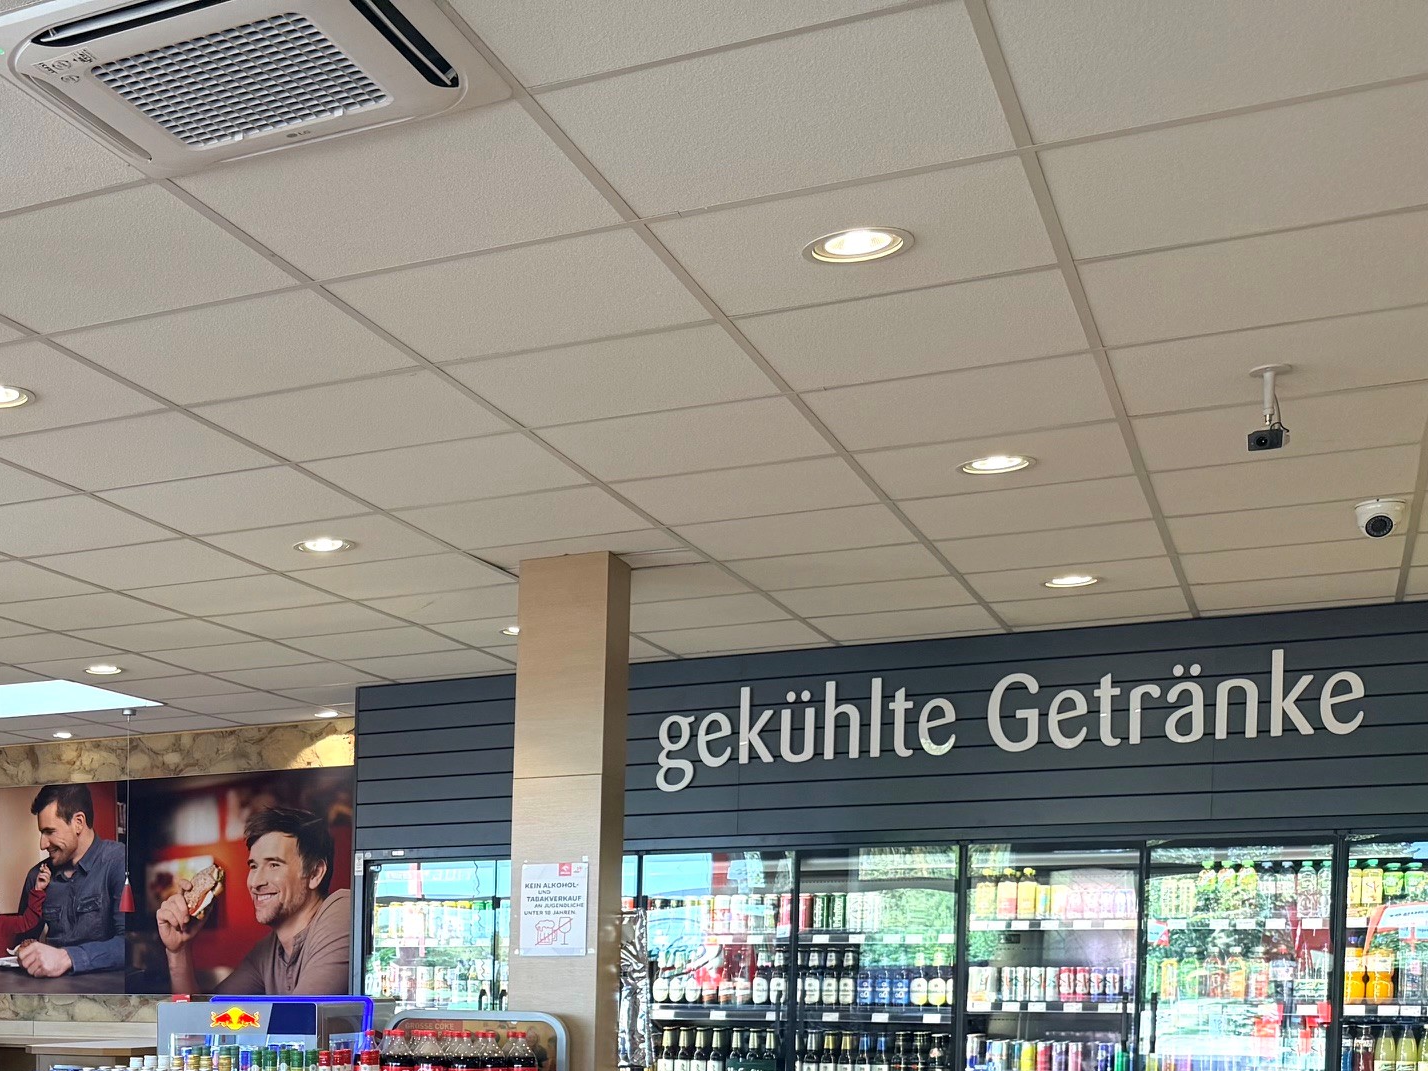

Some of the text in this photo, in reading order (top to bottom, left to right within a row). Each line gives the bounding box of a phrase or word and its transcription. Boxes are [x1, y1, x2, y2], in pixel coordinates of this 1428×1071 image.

[655, 649, 1366, 792] gekühlte Getränke
[404, 1022, 454, 1030] GROSSE COKE
